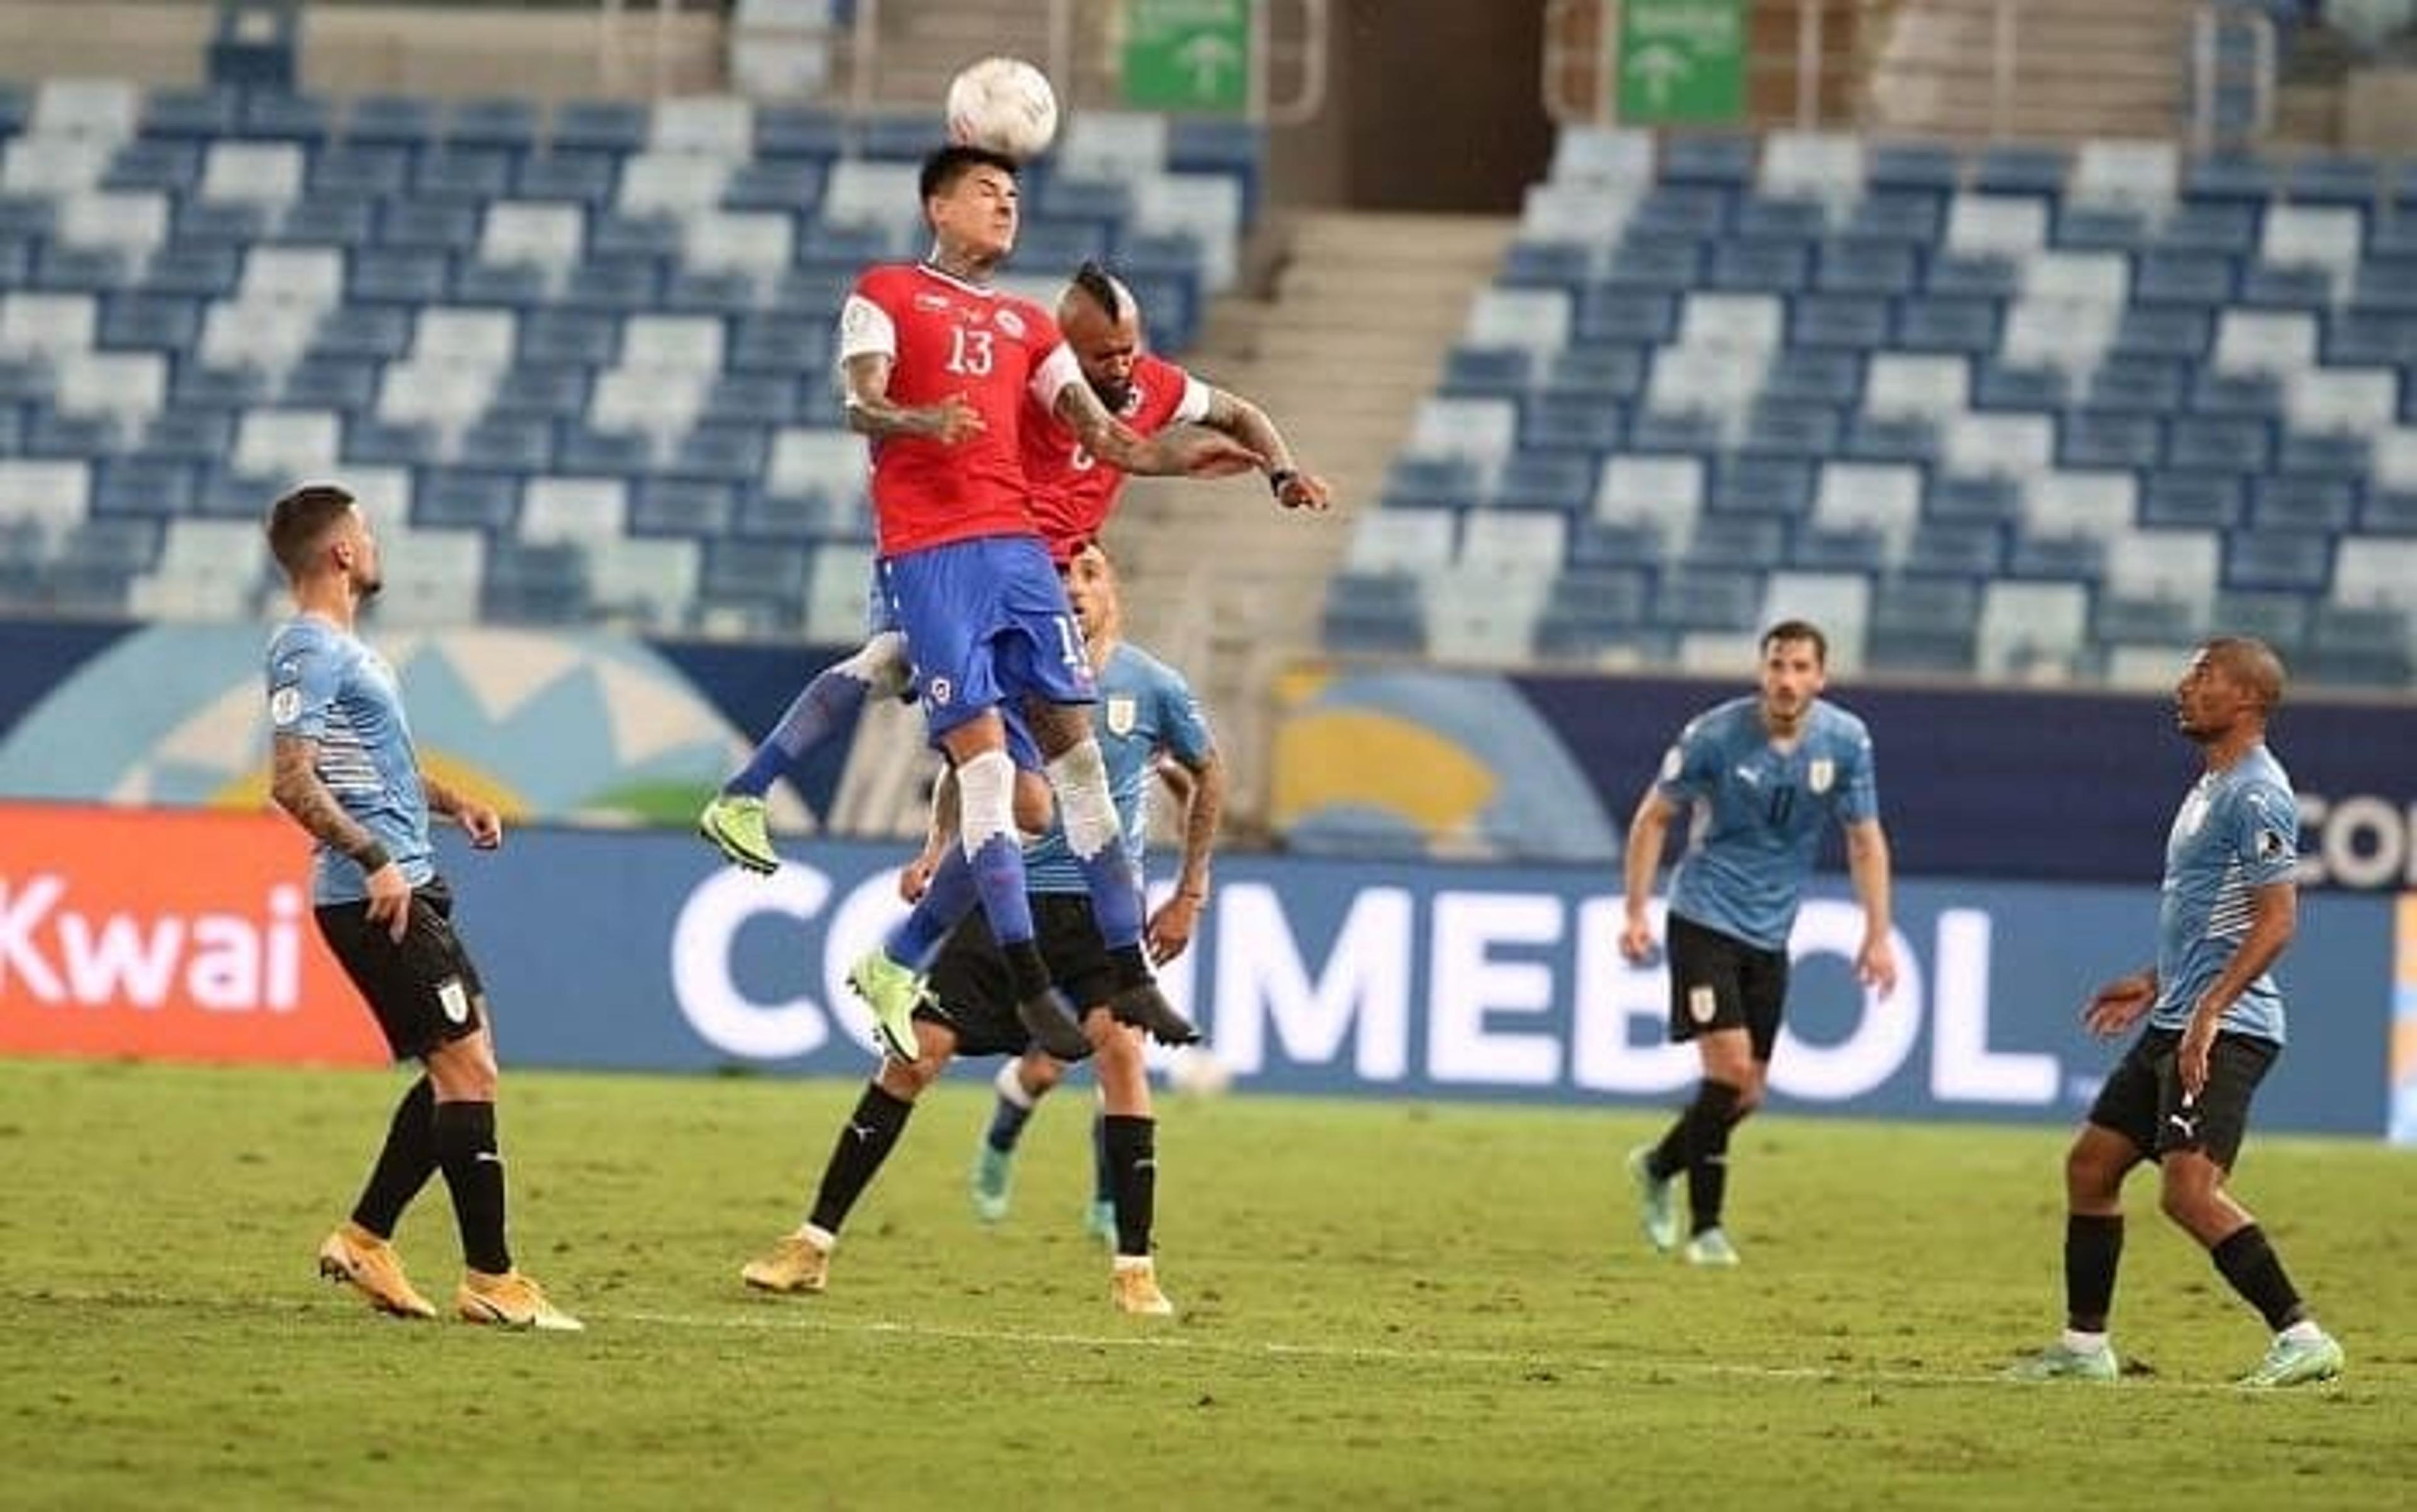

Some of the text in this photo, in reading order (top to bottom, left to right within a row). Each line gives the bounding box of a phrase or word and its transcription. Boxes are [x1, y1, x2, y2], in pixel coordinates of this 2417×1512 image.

[945, 325, 993, 376] 13
[1770, 786, 1796, 824] 11
[2286, 794, 2417, 888] CO
[0, 874, 301, 1013] Kwai
[672, 861, 2059, 1104] CMEBOL
